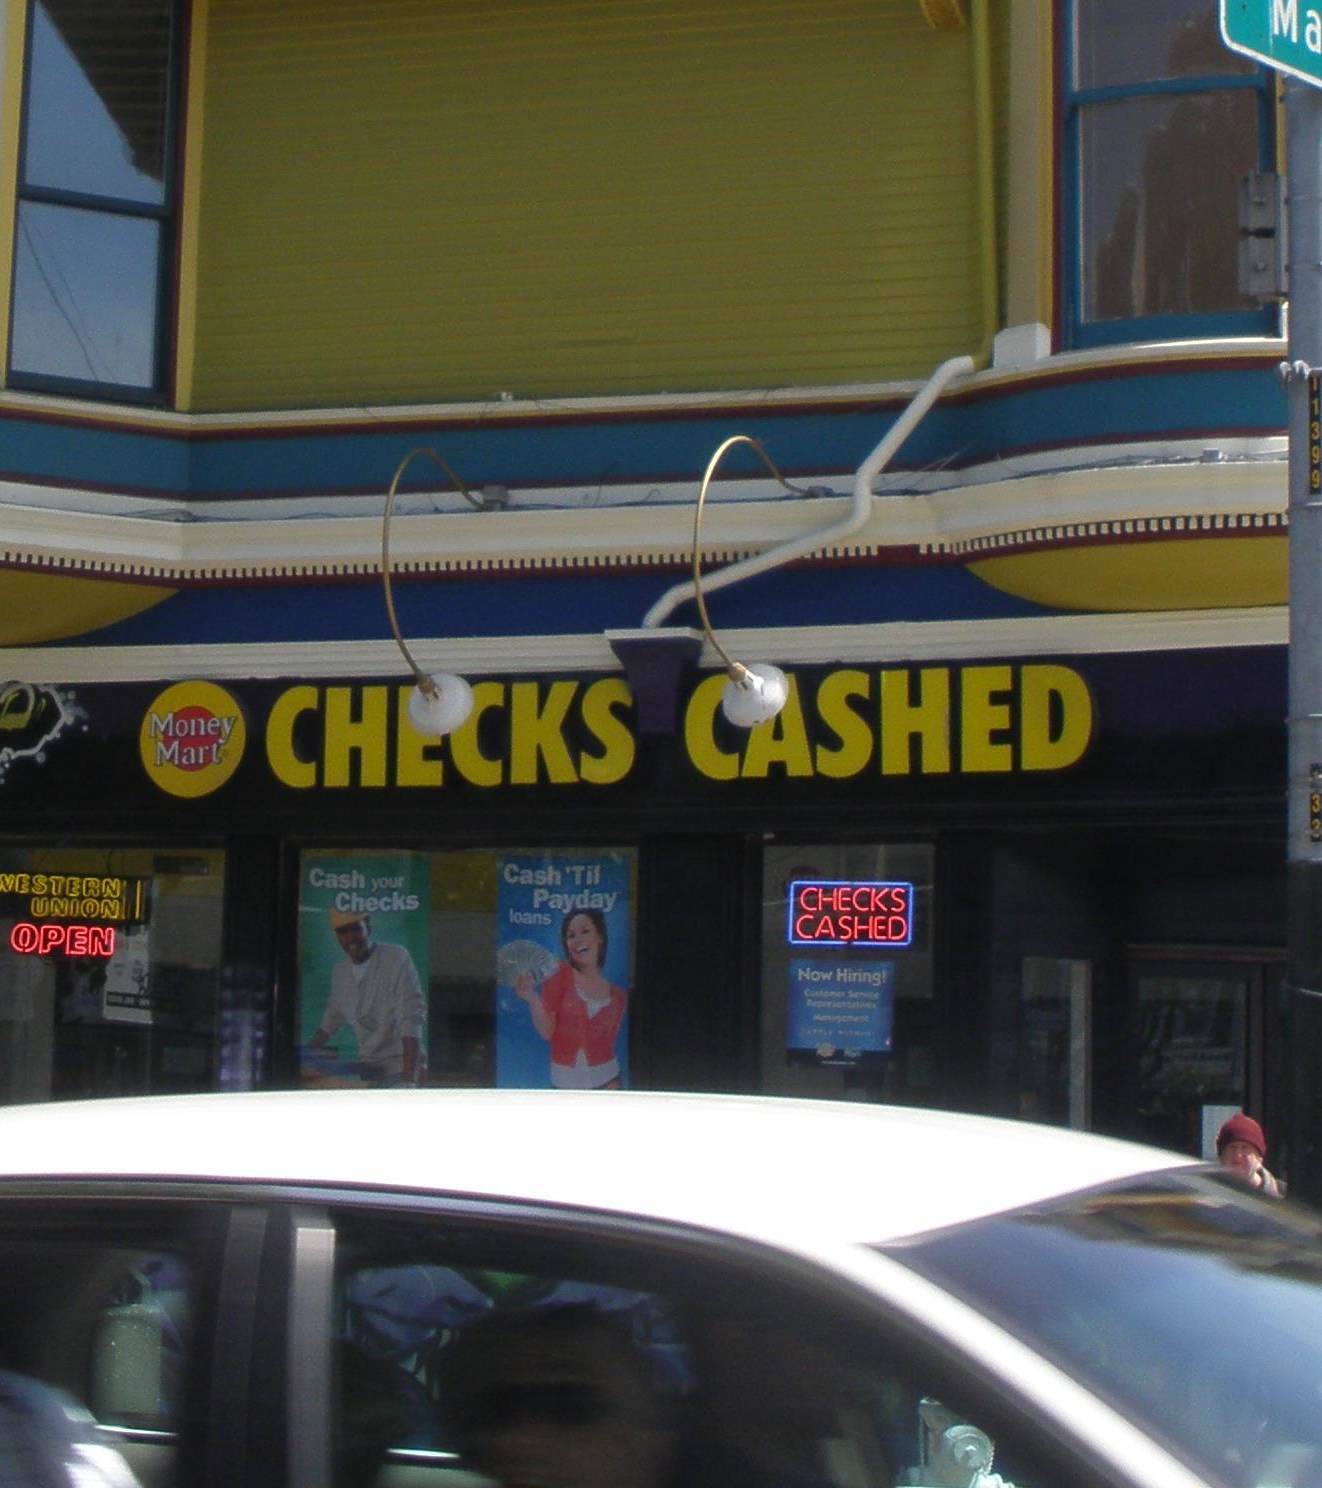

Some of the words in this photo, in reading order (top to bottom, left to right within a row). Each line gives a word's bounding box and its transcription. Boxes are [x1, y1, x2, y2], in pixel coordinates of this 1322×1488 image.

[148, 711, 237, 746] Money
[265, 676, 637, 790] CHECKS
[683, 663, 1094, 781] CASHED
[155, 740, 223, 766] Mart
[308, 866, 366, 890] Cash
[371, 875, 406, 892] your
[503, 862, 562, 886] Cash
[30, 896, 121, 920] UNION
[334, 891, 420, 912] Checks
[532, 888, 618, 914] Payday
[799, 886, 907, 913] CHECKS
[508, 908, 552, 926] loans
[795, 914, 908, 941] CASHED
[10, 922, 116, 957] OPEN
[797, 967, 833, 982] Now
[836, 967, 887, 987] Hiring!
